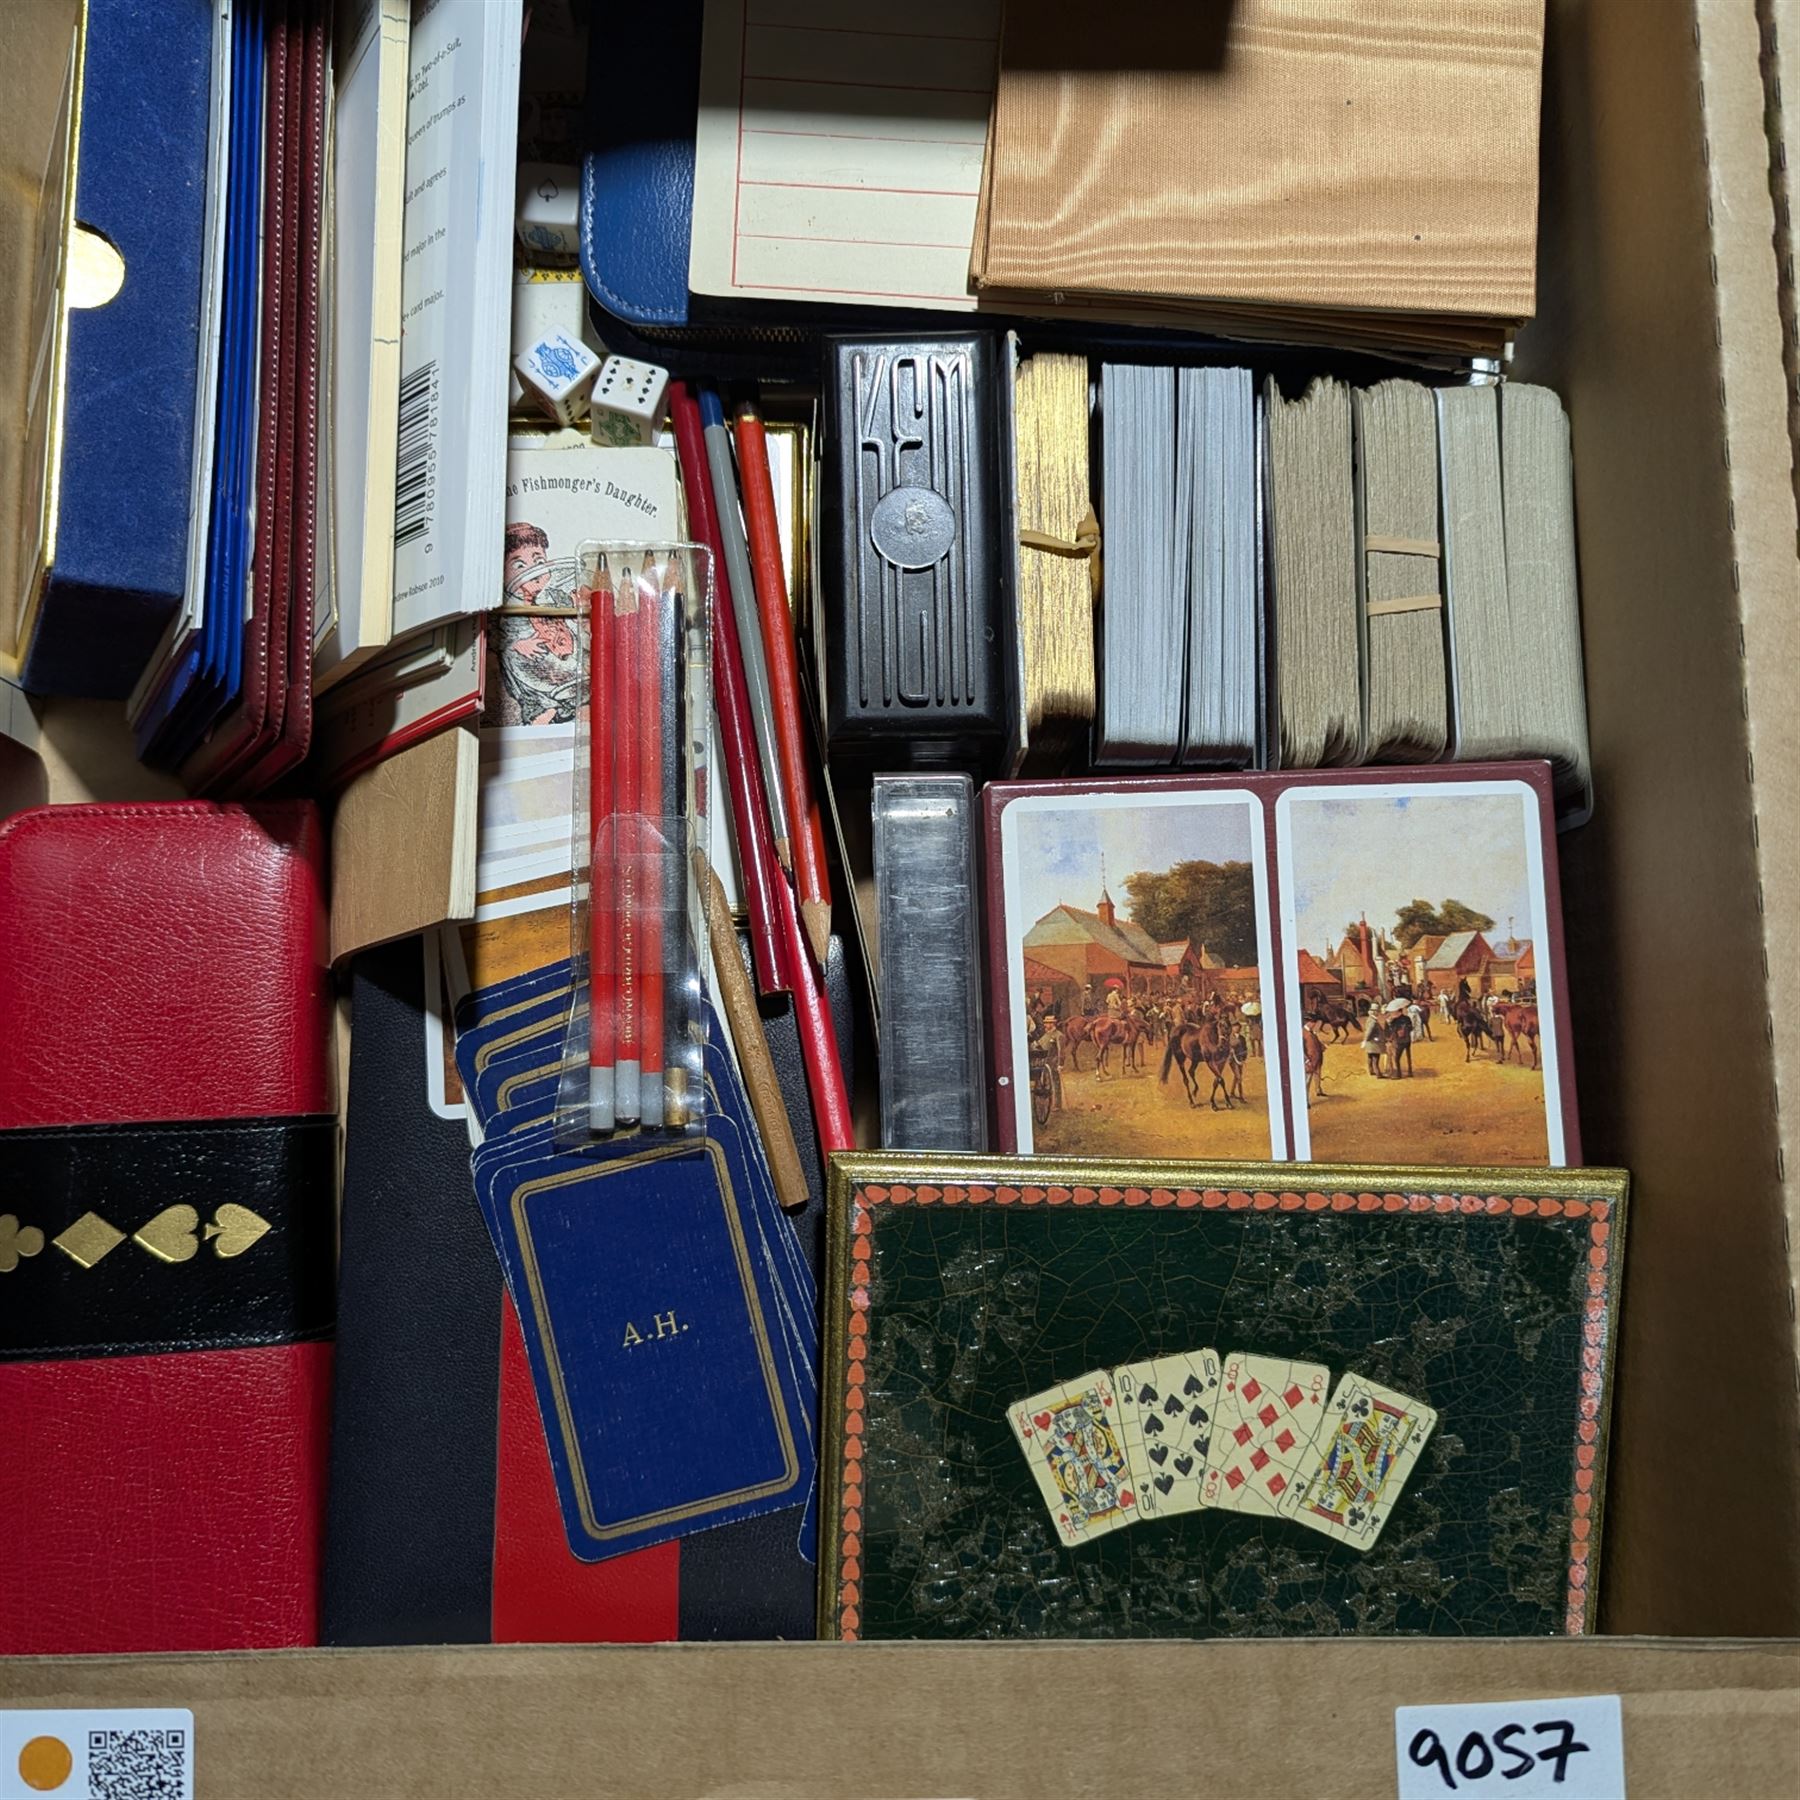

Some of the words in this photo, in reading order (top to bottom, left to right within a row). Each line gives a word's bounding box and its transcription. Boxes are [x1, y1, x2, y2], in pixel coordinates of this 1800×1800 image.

[428, 367, 441, 442] 781841
[424, 449, 437, 526] 780955
[521, 475, 601, 494] Fishmonger's
[604, 481, 658, 518] Daughter.
[428, 574, 445, 590] 2010
[622, 1310, 689, 1348] A.H.
[1202, 1357, 1217, 1377] 10
[1227, 1362, 1240, 1380] 8
[1118, 1373, 1132, 1394] 10
[1311, 1374, 1323, 1392] 8
[1407, 1719, 1591, 1790] 9057
